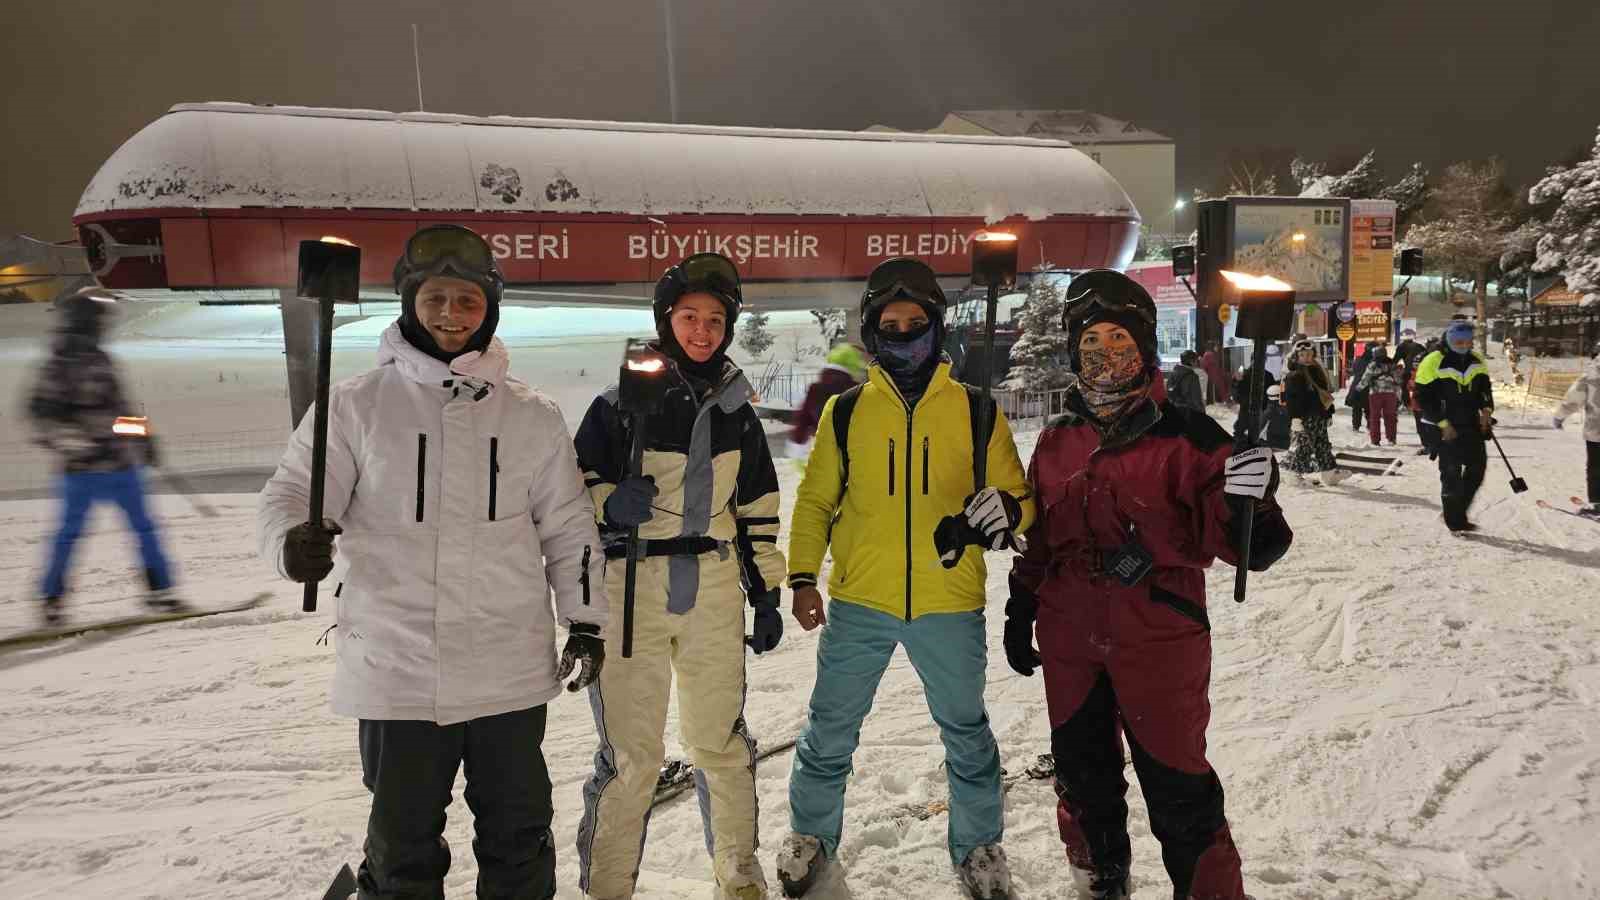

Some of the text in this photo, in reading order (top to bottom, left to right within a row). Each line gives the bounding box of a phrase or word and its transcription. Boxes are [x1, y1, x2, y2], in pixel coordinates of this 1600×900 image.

[482, 229, 975, 264] SERİ BÜYÜKŞEHİR BELEDİY
[1115, 555, 1142, 577] JBL
